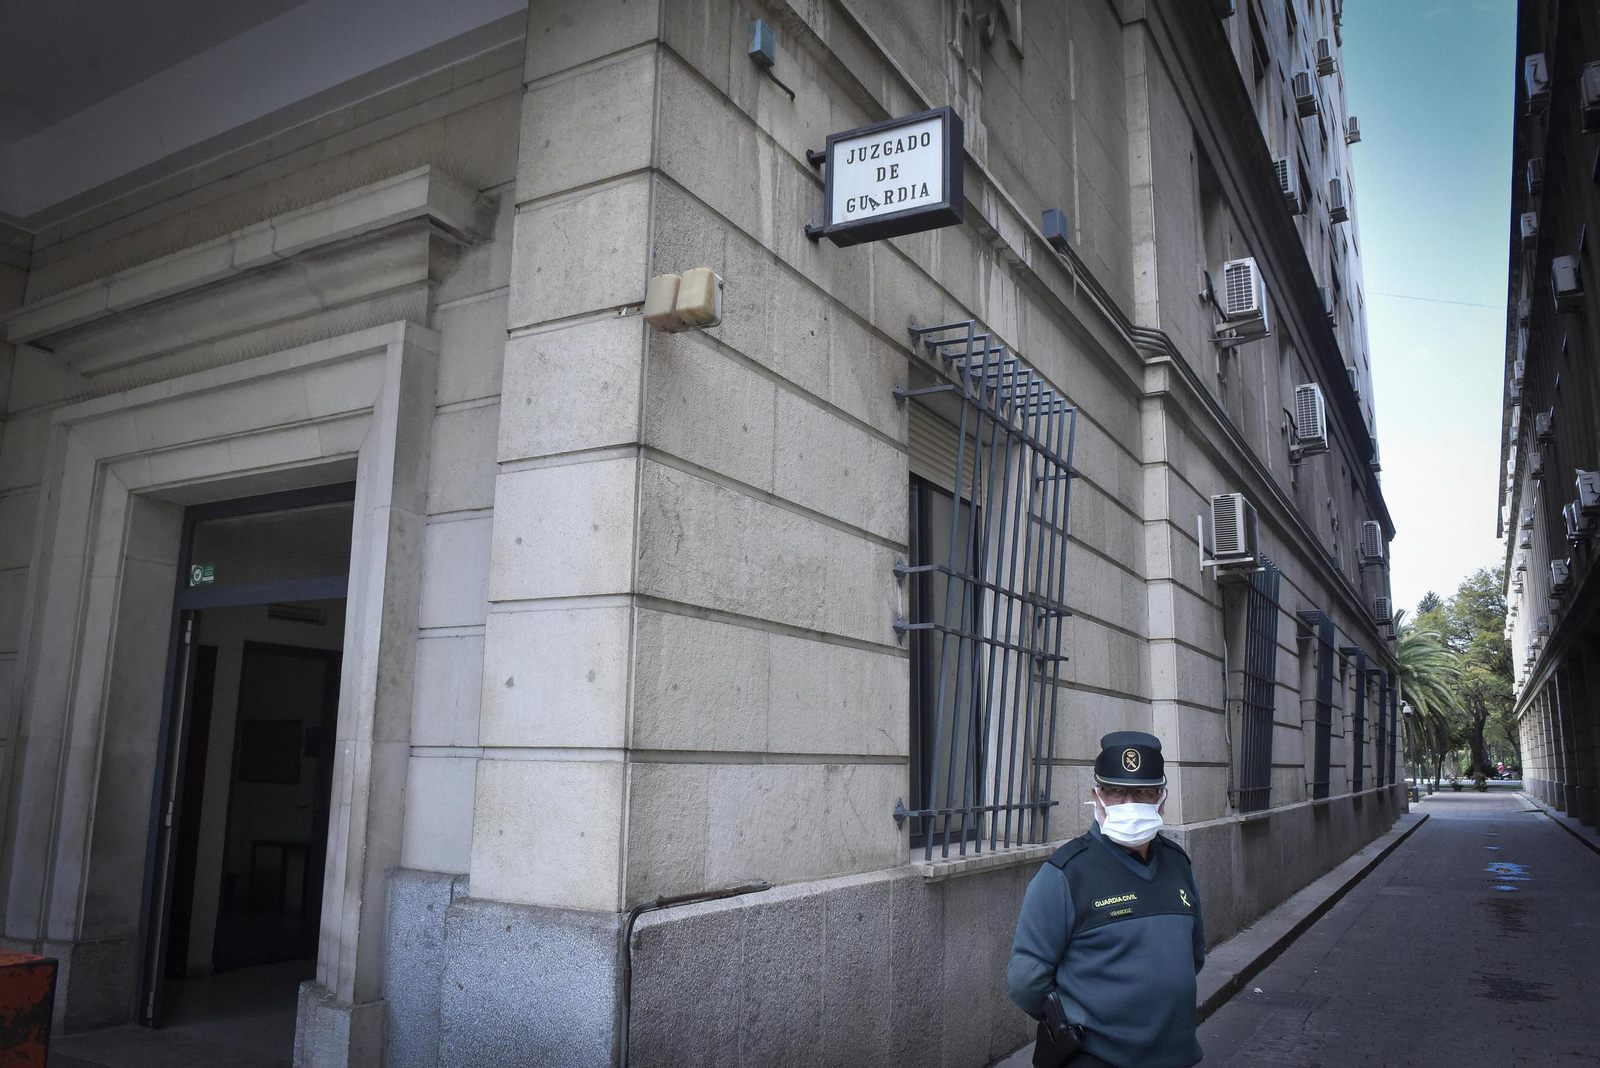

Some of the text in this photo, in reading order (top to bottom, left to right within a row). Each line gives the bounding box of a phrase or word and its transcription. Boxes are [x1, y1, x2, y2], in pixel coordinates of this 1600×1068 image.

[846, 132, 931, 165] JUZGADO
[876, 163, 899, 183] DE
[846, 182, 930, 212] GUARDIA
[1094, 894, 1138, 908] GUARDIA CIVIL
